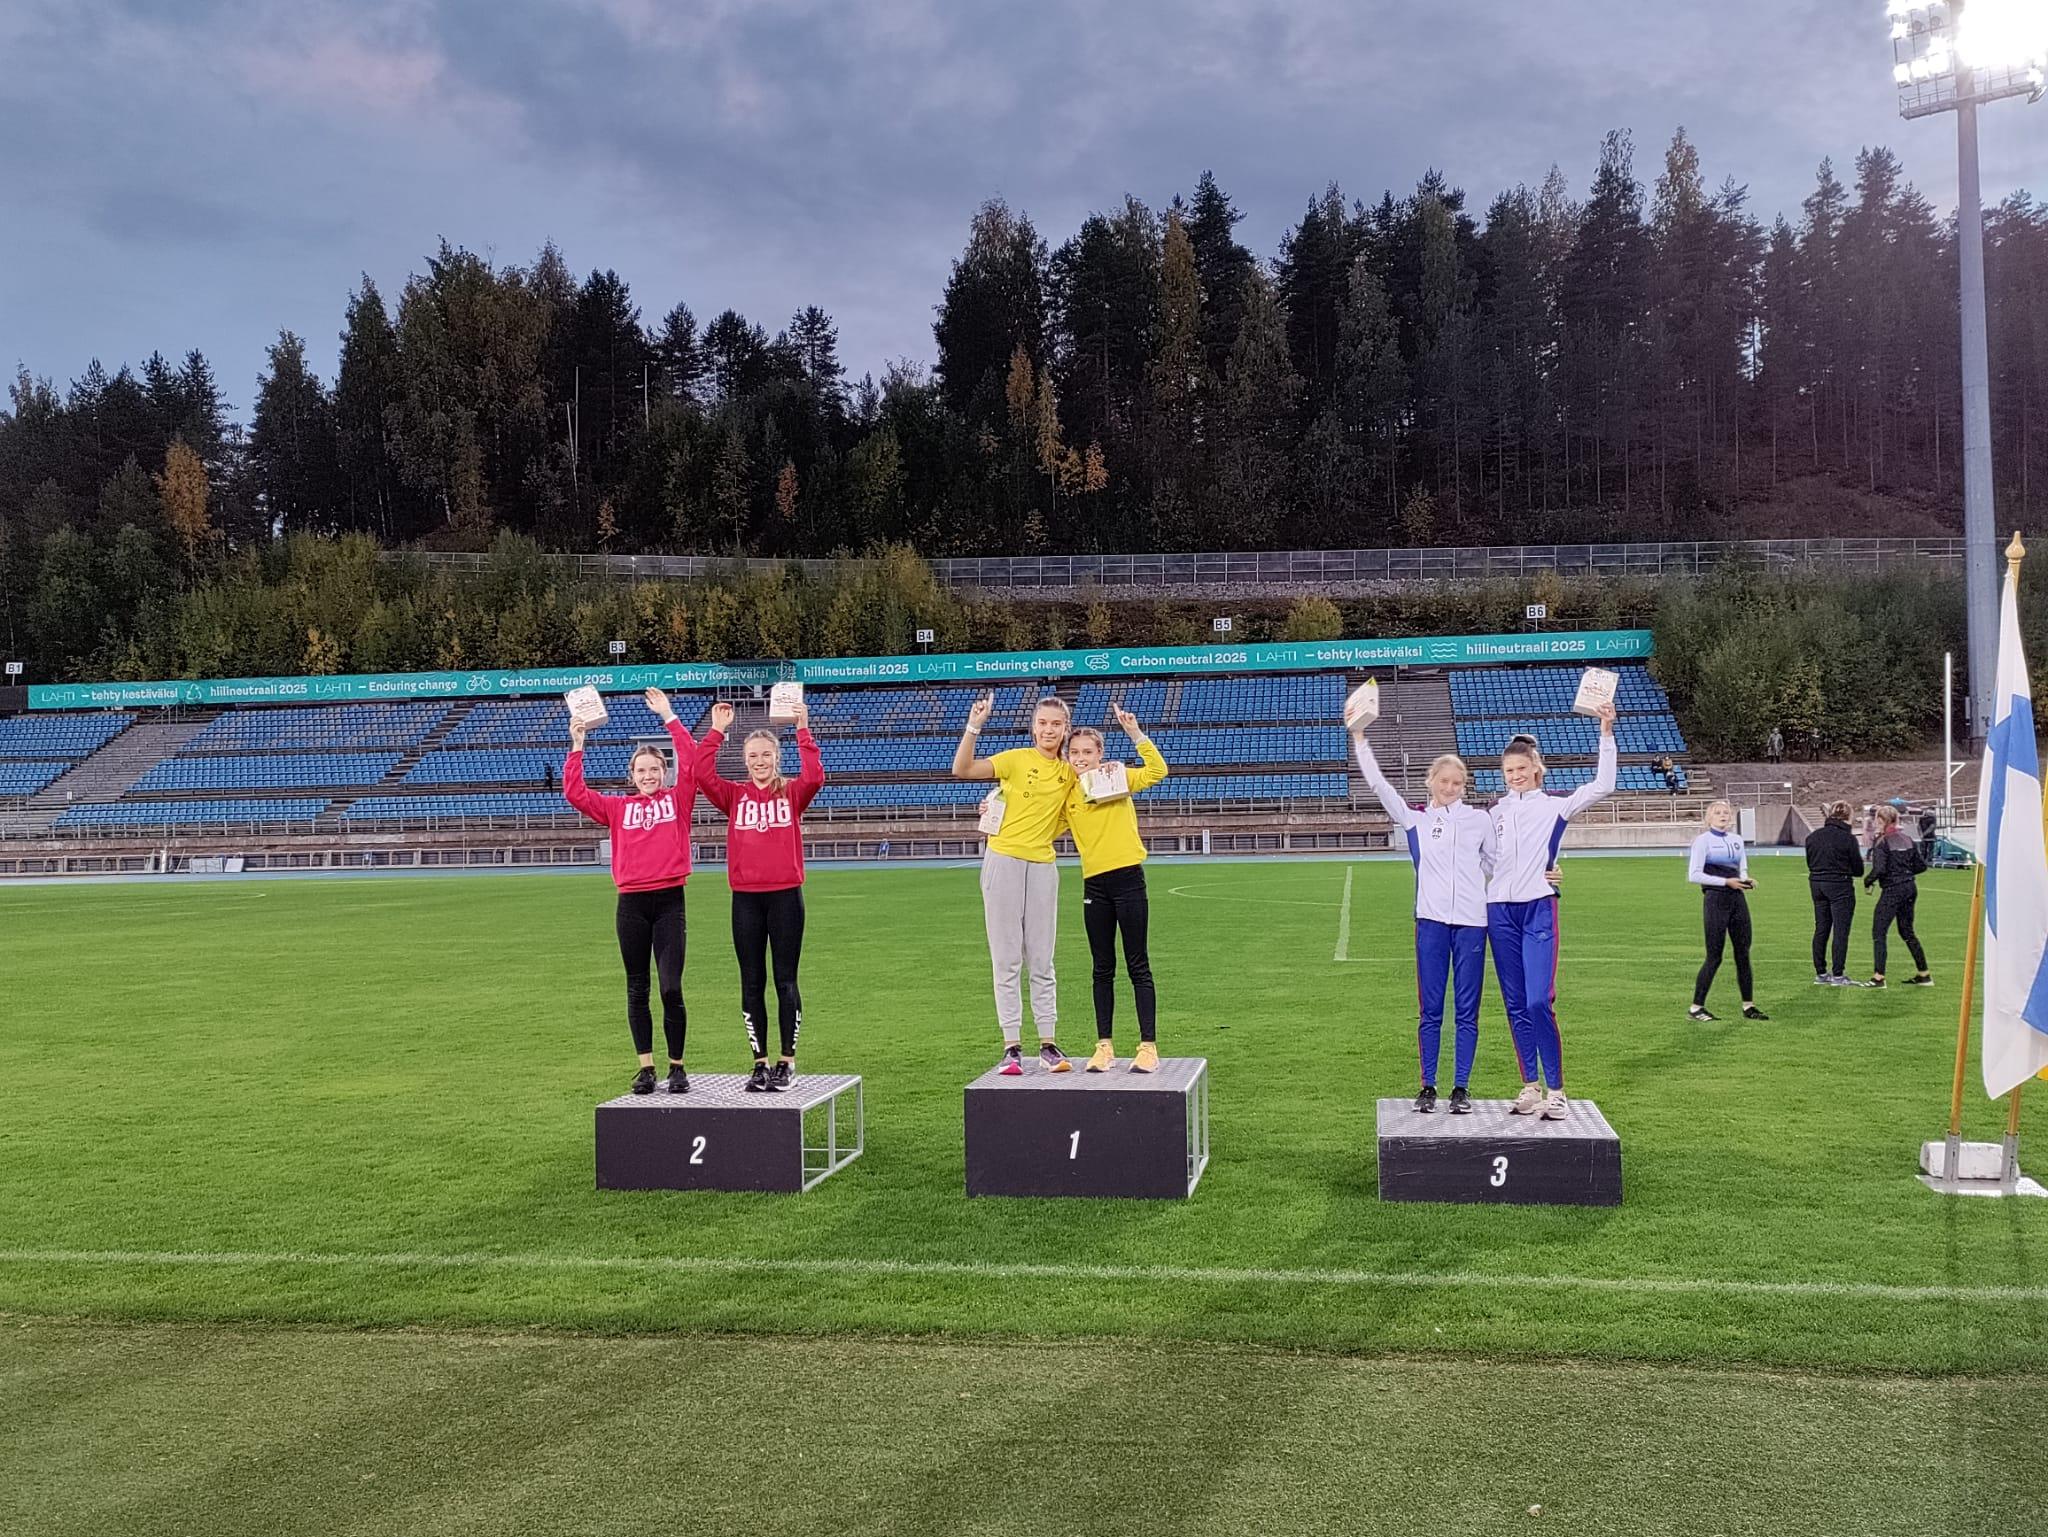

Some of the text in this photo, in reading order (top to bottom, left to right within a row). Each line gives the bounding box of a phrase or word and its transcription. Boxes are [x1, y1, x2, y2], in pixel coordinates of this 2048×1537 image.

[1528, 606, 1544, 617] B6
[1215, 619, 1230, 630] B5
[918, 631, 932, 641] B4
[611, 642, 624, 652] B3
[1466, 640, 1586, 656] hiilineutraali 2025
[1596, 639, 1640, 651] LAHTI
[1120, 652, 1247, 667] Carbon neutral 2025
[1256, 645, 1423, 663] LAHTI tehty kestäväksi
[8, 663, 21, 673] B1
[878, 663, 909, 675] 2025
[918, 657, 1074, 674] LAHTI Enduring change
[499, 673, 613, 688] Carbon neutral 2025
[621, 672, 658, 684] LAHTI
[675, 670, 707, 683] tehty
[209, 683, 308, 697] hiilineutraali 2025
[315, 679, 458, 693] LAHTI Enduring change
[41, 687, 178, 702] LAHTI tehty kestäväksi
[742, 1011, 760, 1053] NIKE
[689, 1135, 706, 1164] 2
[1070, 1130, 1080, 1159] 1
[1490, 1155, 1508, 1187] 3
